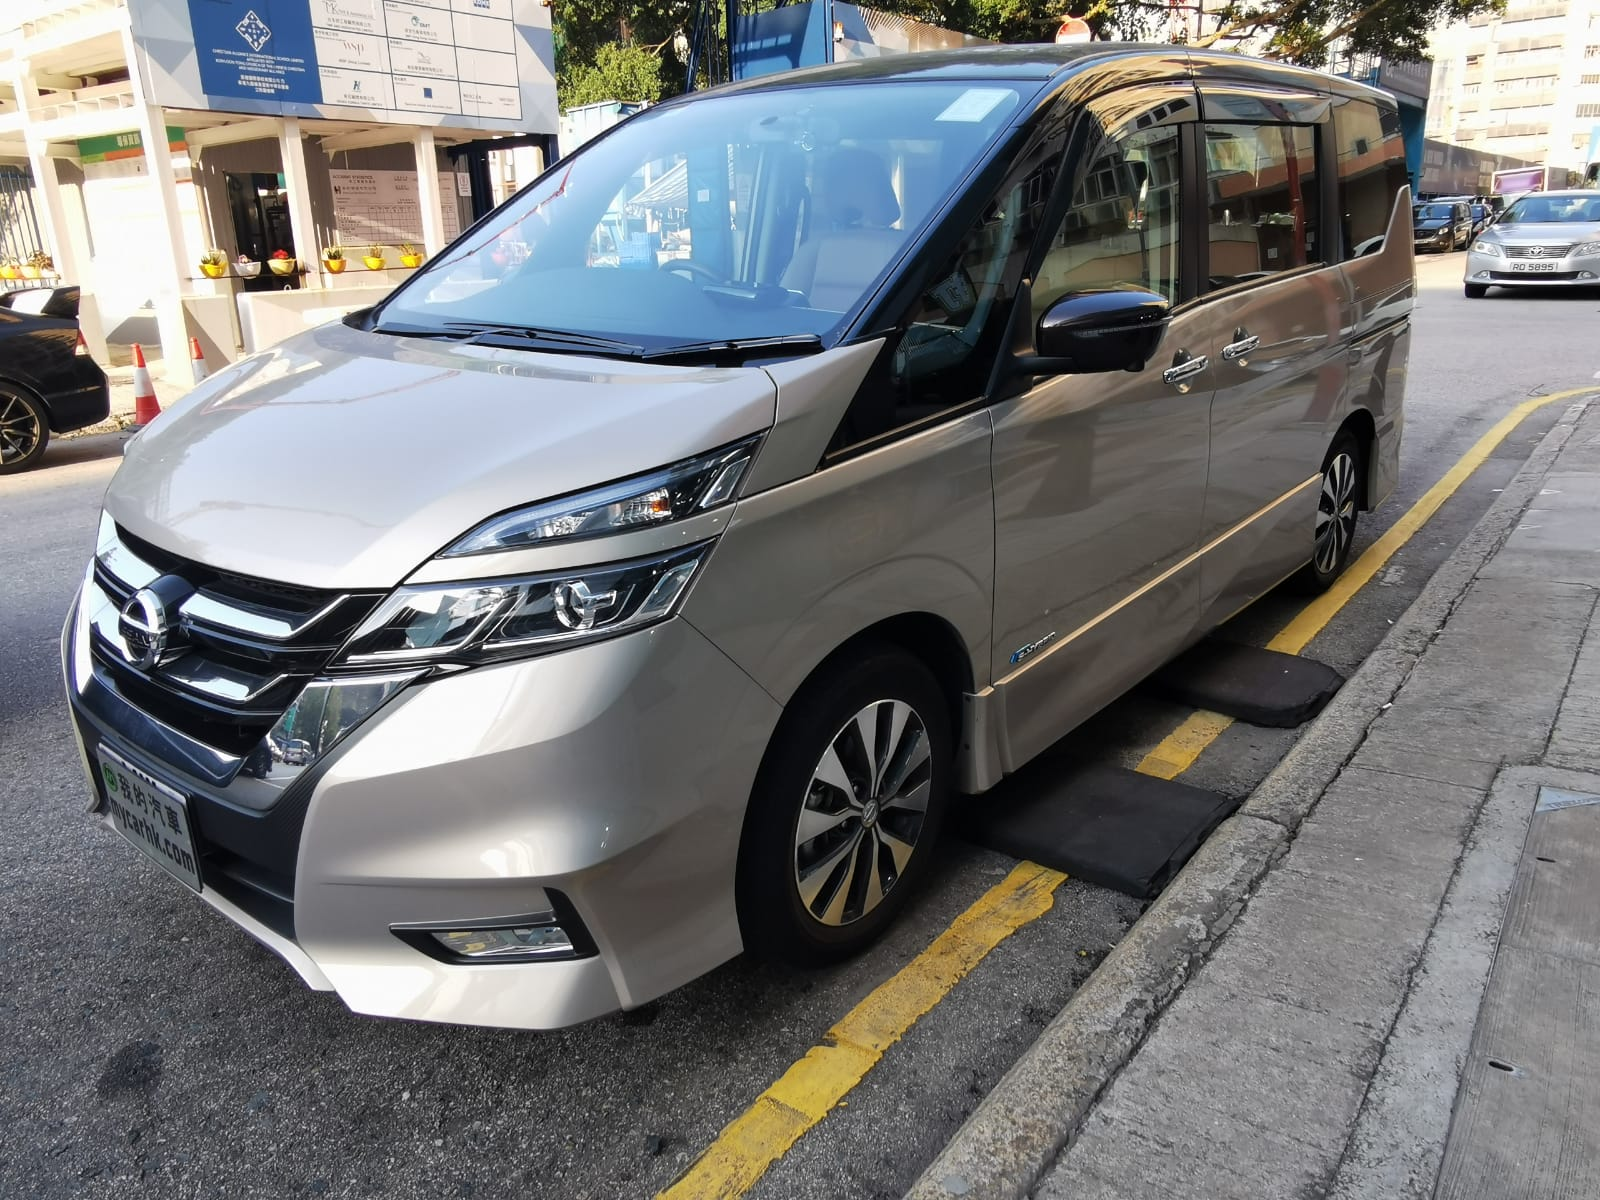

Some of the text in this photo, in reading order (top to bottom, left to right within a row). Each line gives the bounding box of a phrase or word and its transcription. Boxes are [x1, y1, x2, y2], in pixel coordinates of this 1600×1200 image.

[1528, 263, 1554, 271] 5895
[110, 797, 195, 875] mycarhk.com
[117, 771, 183, 836] 我的汽車
